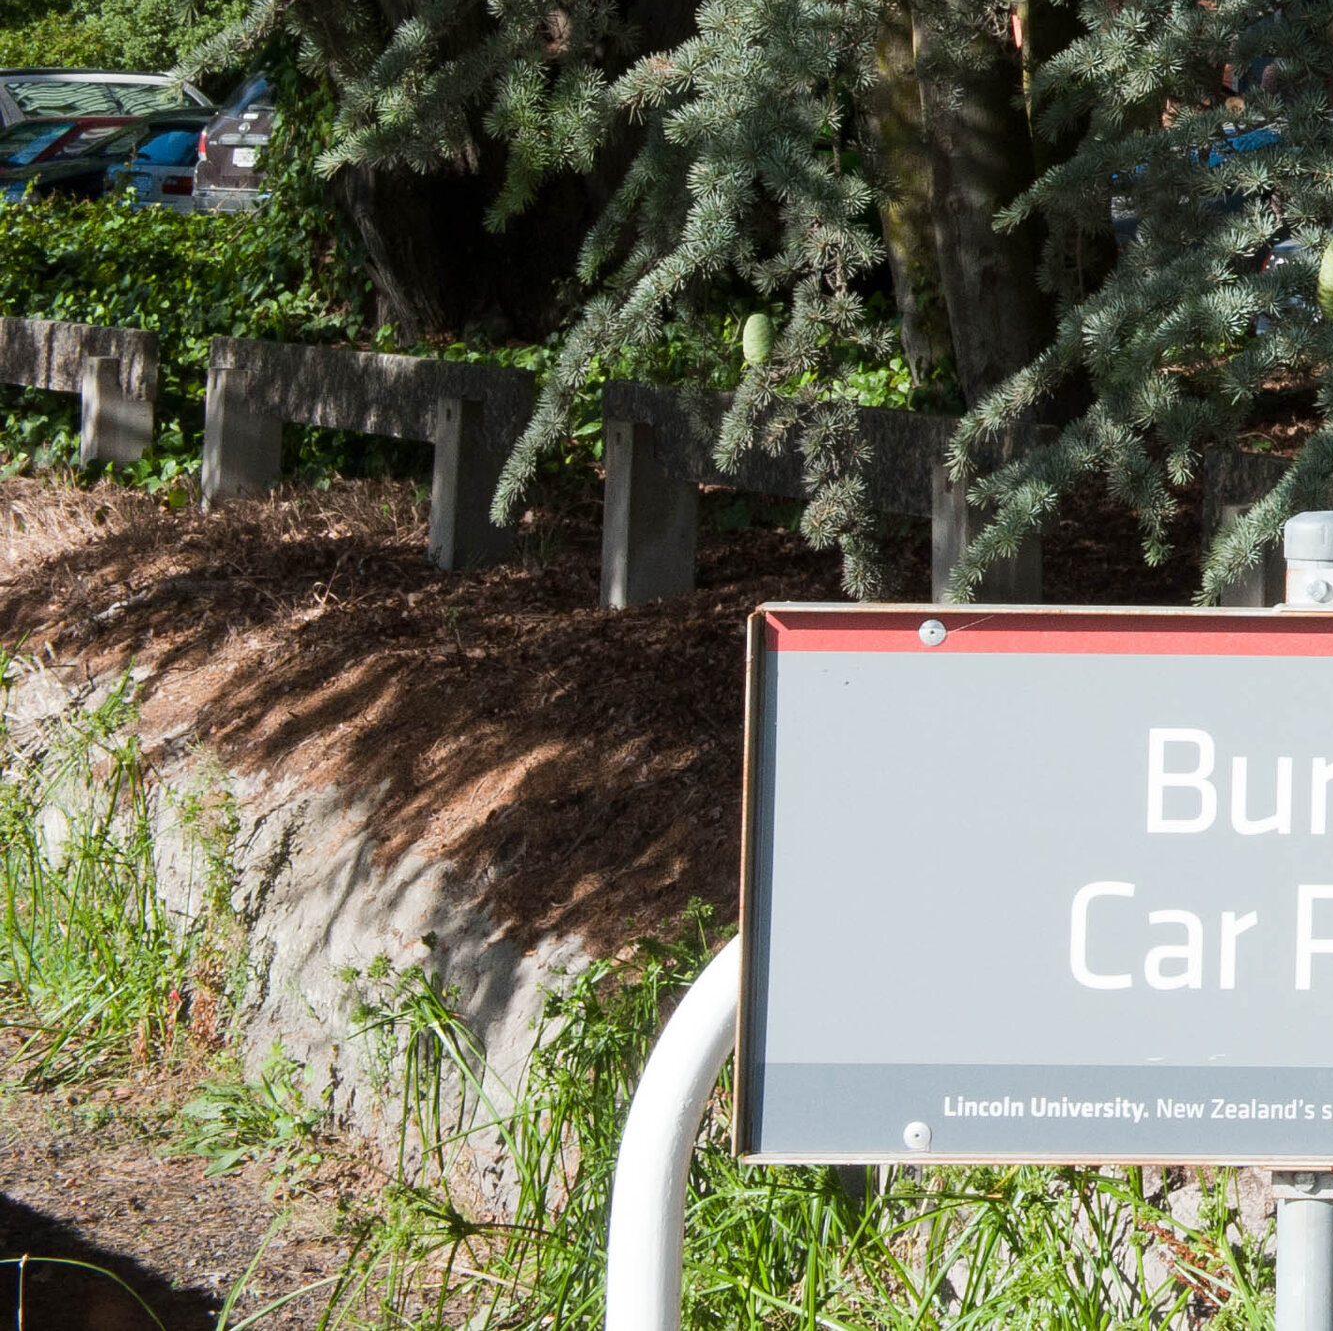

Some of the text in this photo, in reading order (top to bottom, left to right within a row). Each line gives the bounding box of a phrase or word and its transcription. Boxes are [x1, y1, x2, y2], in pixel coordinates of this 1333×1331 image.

[1069, 880, 1258, 991] Car
[943, 1096, 1025, 1118] Lincoln
[1030, 1096, 1150, 1124] University.
[1156, 1098, 1206, 1119] New
